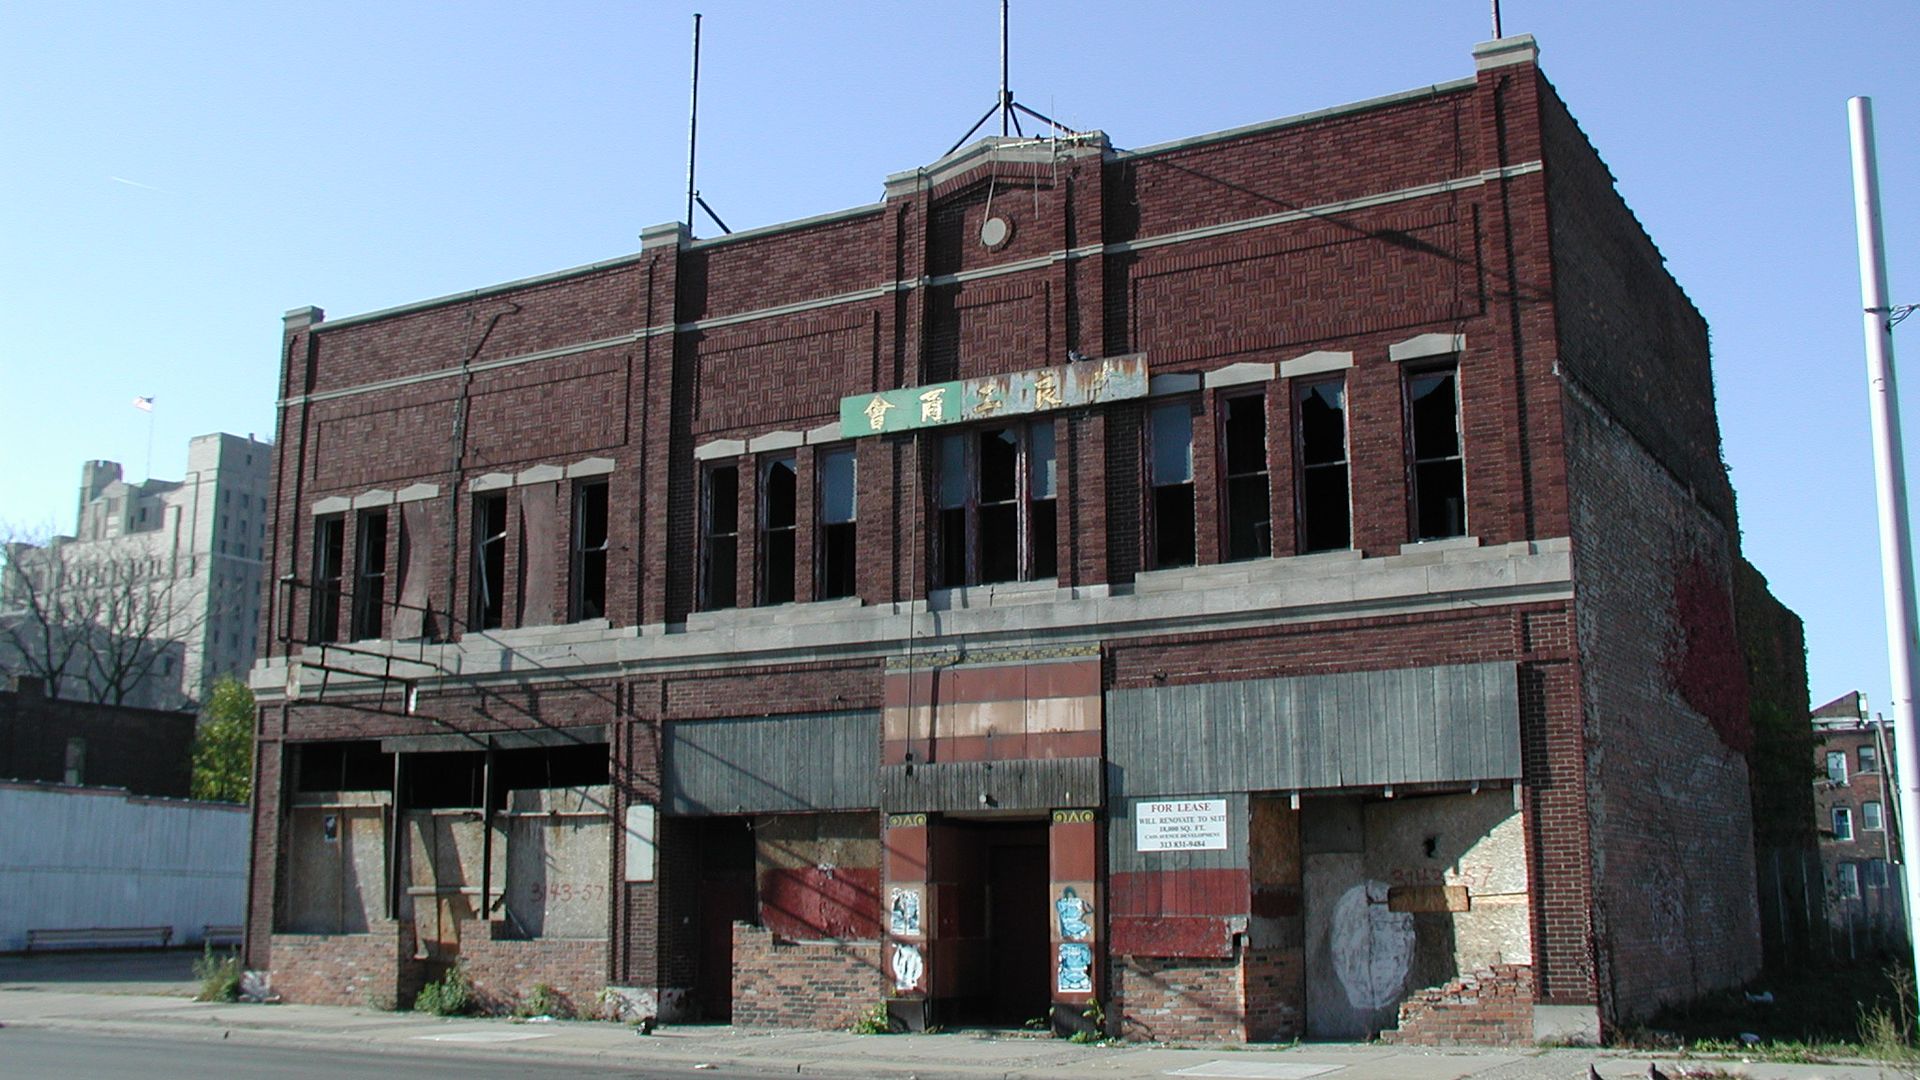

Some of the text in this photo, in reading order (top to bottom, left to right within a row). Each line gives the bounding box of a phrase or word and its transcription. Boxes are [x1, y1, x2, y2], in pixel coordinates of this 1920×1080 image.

[1151, 802, 1212, 813] FOR LEASE
[1159, 816, 1194, 824] RENOVATE
